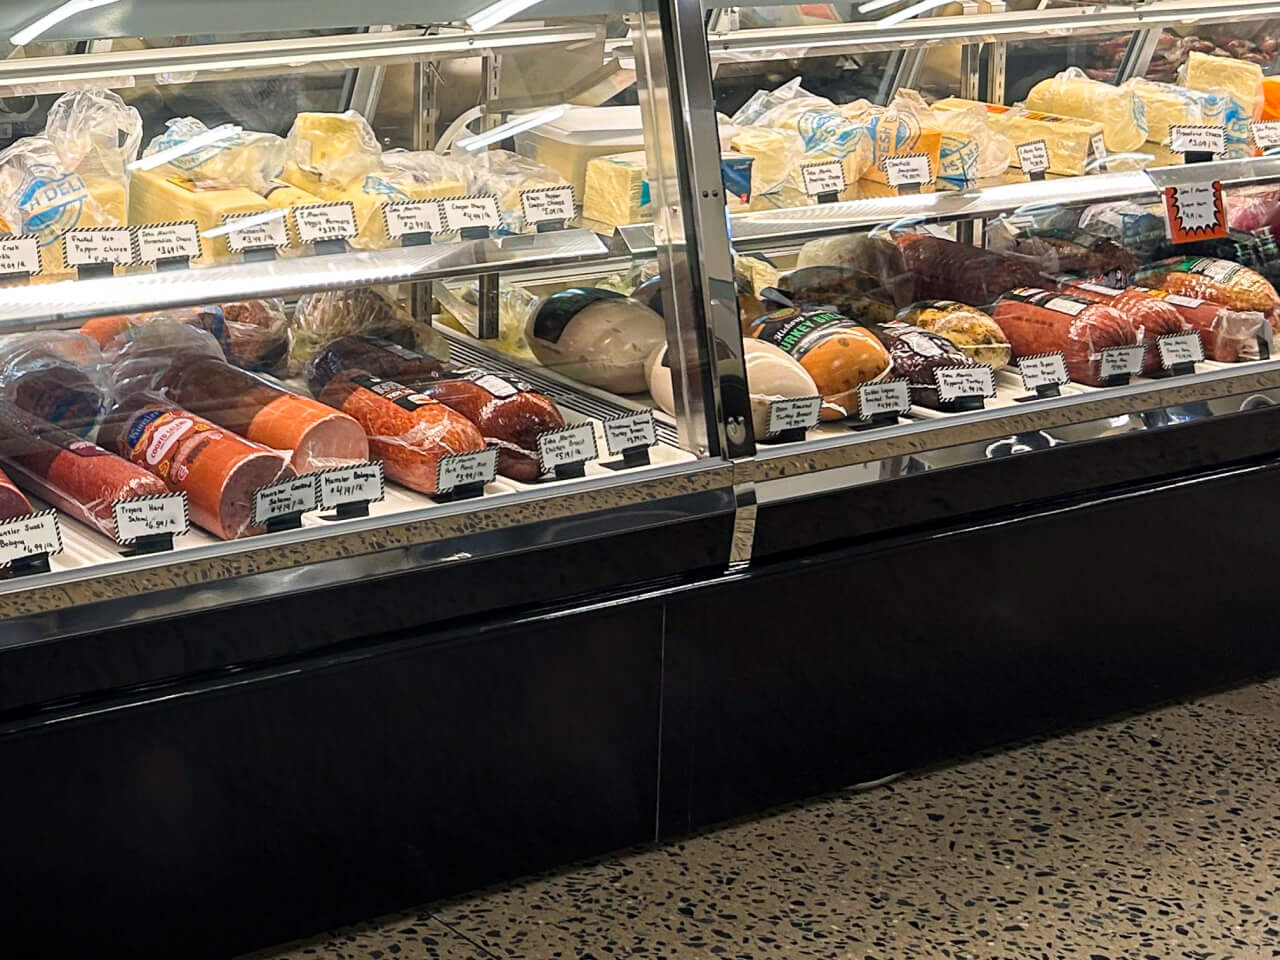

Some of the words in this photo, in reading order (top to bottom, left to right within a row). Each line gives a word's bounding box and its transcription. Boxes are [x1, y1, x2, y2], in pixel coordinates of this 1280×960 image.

[44, 176, 86, 202] DELI
[148, 503, 164, 511] Hard
[128, 515, 148, 523] Salami
[24, 523, 44, 531] Sweet
[0, 539, 25, 549] Bologna
